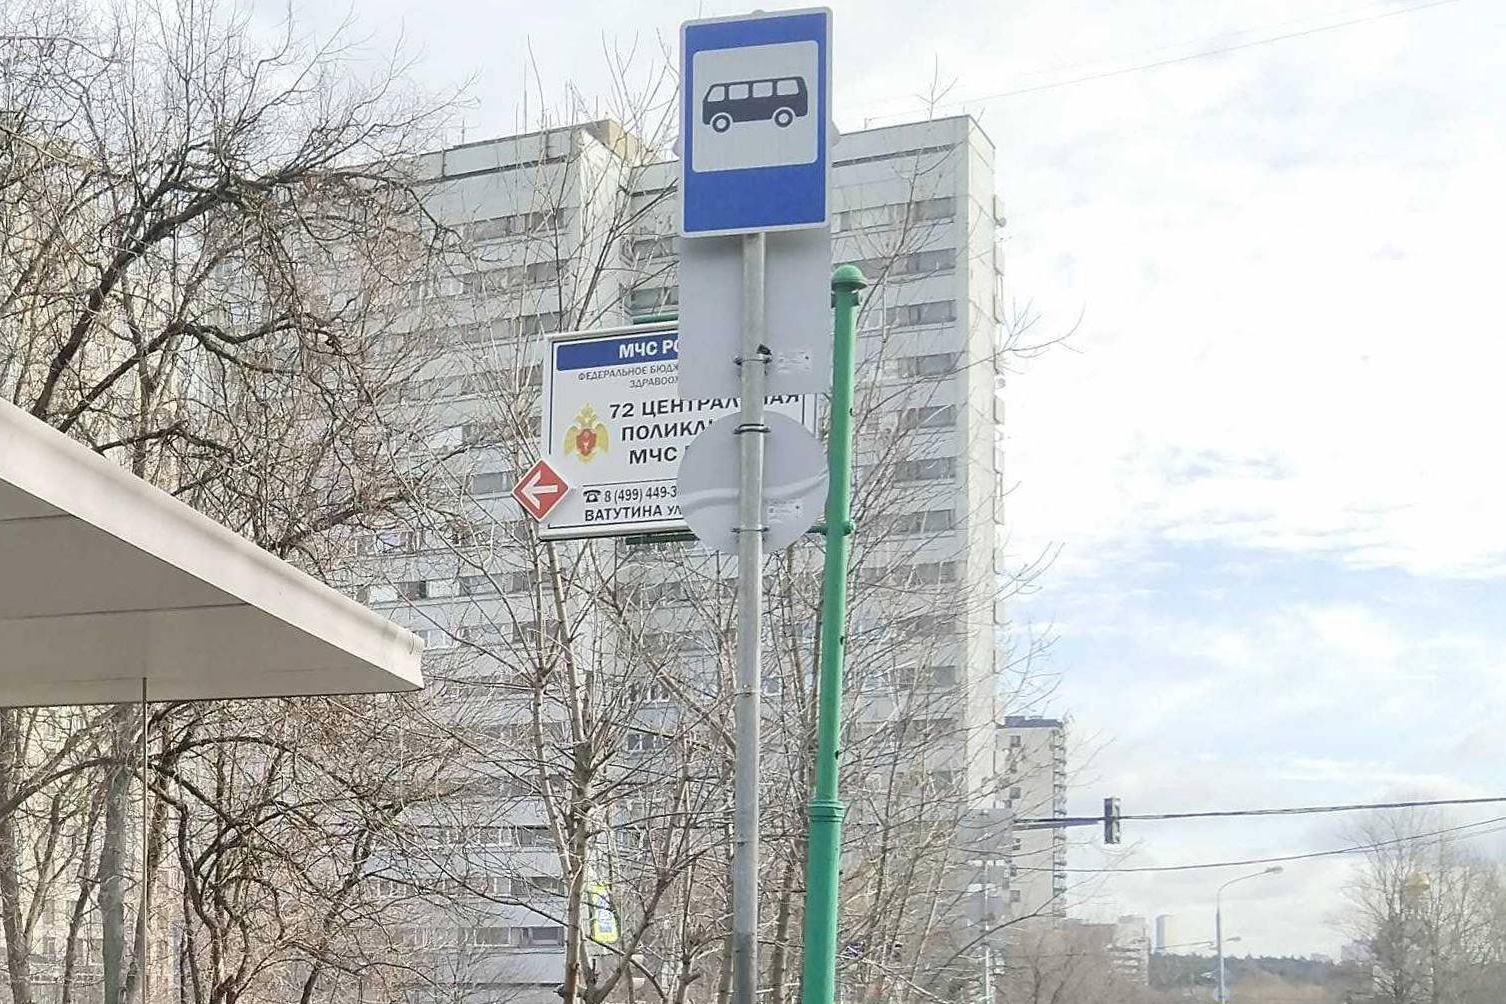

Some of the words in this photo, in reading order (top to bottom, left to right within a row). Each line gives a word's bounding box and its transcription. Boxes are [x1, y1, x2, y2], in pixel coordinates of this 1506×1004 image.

[618, 341, 658, 359] МЧС
[577, 365, 648, 381] ФЕДЕРАЛЬНОЕ
[609, 403, 634, 419] 72
[641, 394, 799, 418] ЦЕНТРАЛАЯ
[621, 418, 713, 442] ПОЛИКЛ
[629, 446, 677, 464] МЧС
[604, 490, 612, 501] 8
[614, 488, 643, 505] (499)
[584, 504, 663, 522] ВАТУТИНА
